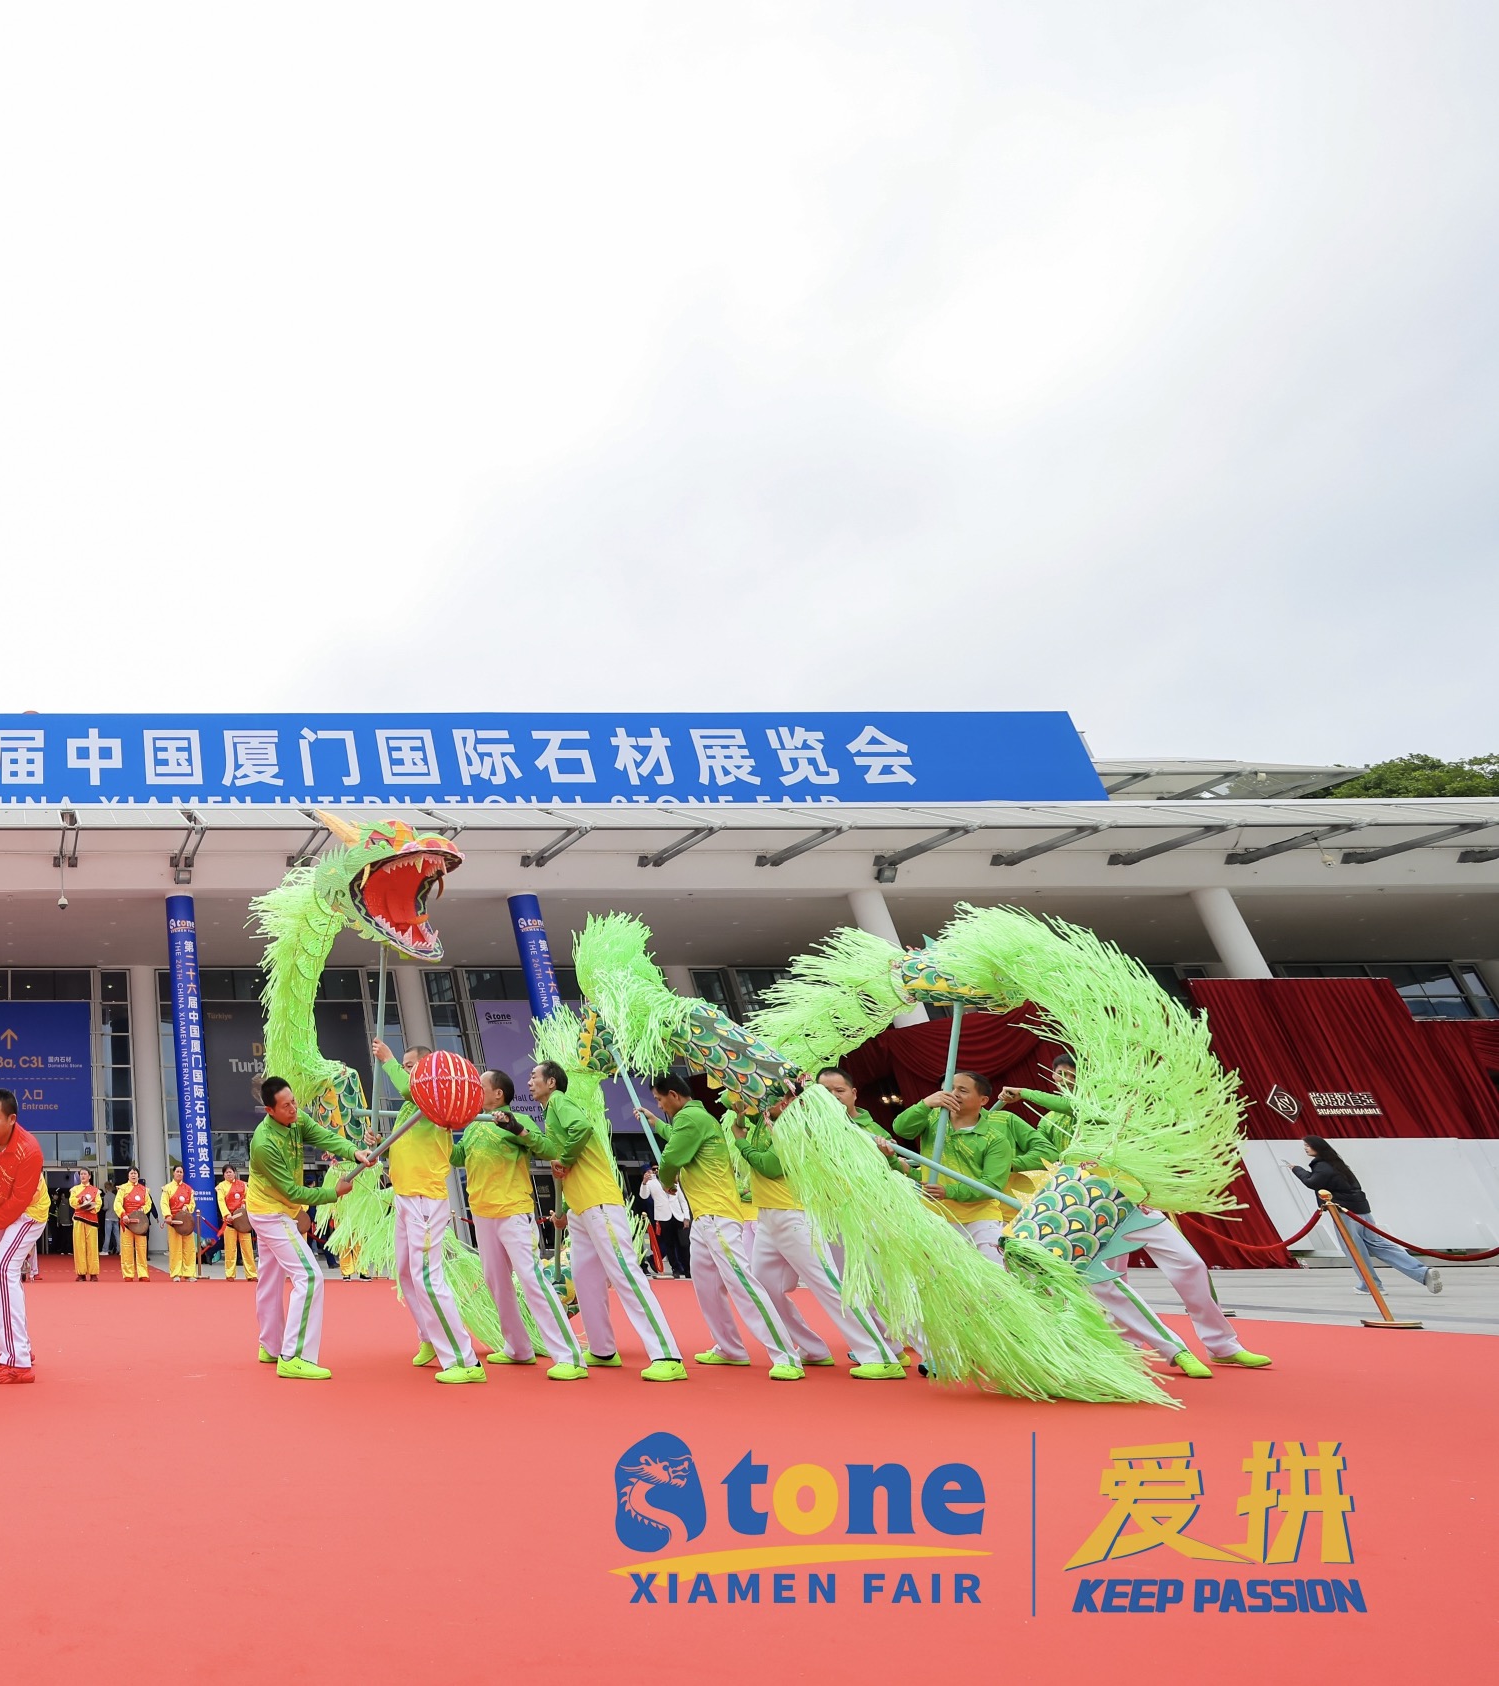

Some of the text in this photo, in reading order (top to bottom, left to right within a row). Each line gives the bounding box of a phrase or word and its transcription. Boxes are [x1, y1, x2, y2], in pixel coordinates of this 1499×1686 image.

[528, 940, 549, 1008] THE 26TH CHINA
[177, 983, 185, 1009] CHINA
[179, 1012, 187, 1045] XIAMEN
[19, 1056, 44, 1068] C3L
[184, 940, 211, 1178] 第二十六届中国厦门国际石材展览会
[229, 1058, 265, 1073] Turk
[22, 1090, 44, 1100] 入口
[181, 1048, 192, 1119] INTERNATIONAL
[22, 1103, 59, 1111] Entrance
[186, 1123, 195, 1154] STONE
[188, 1158, 196, 1178] FAIR
